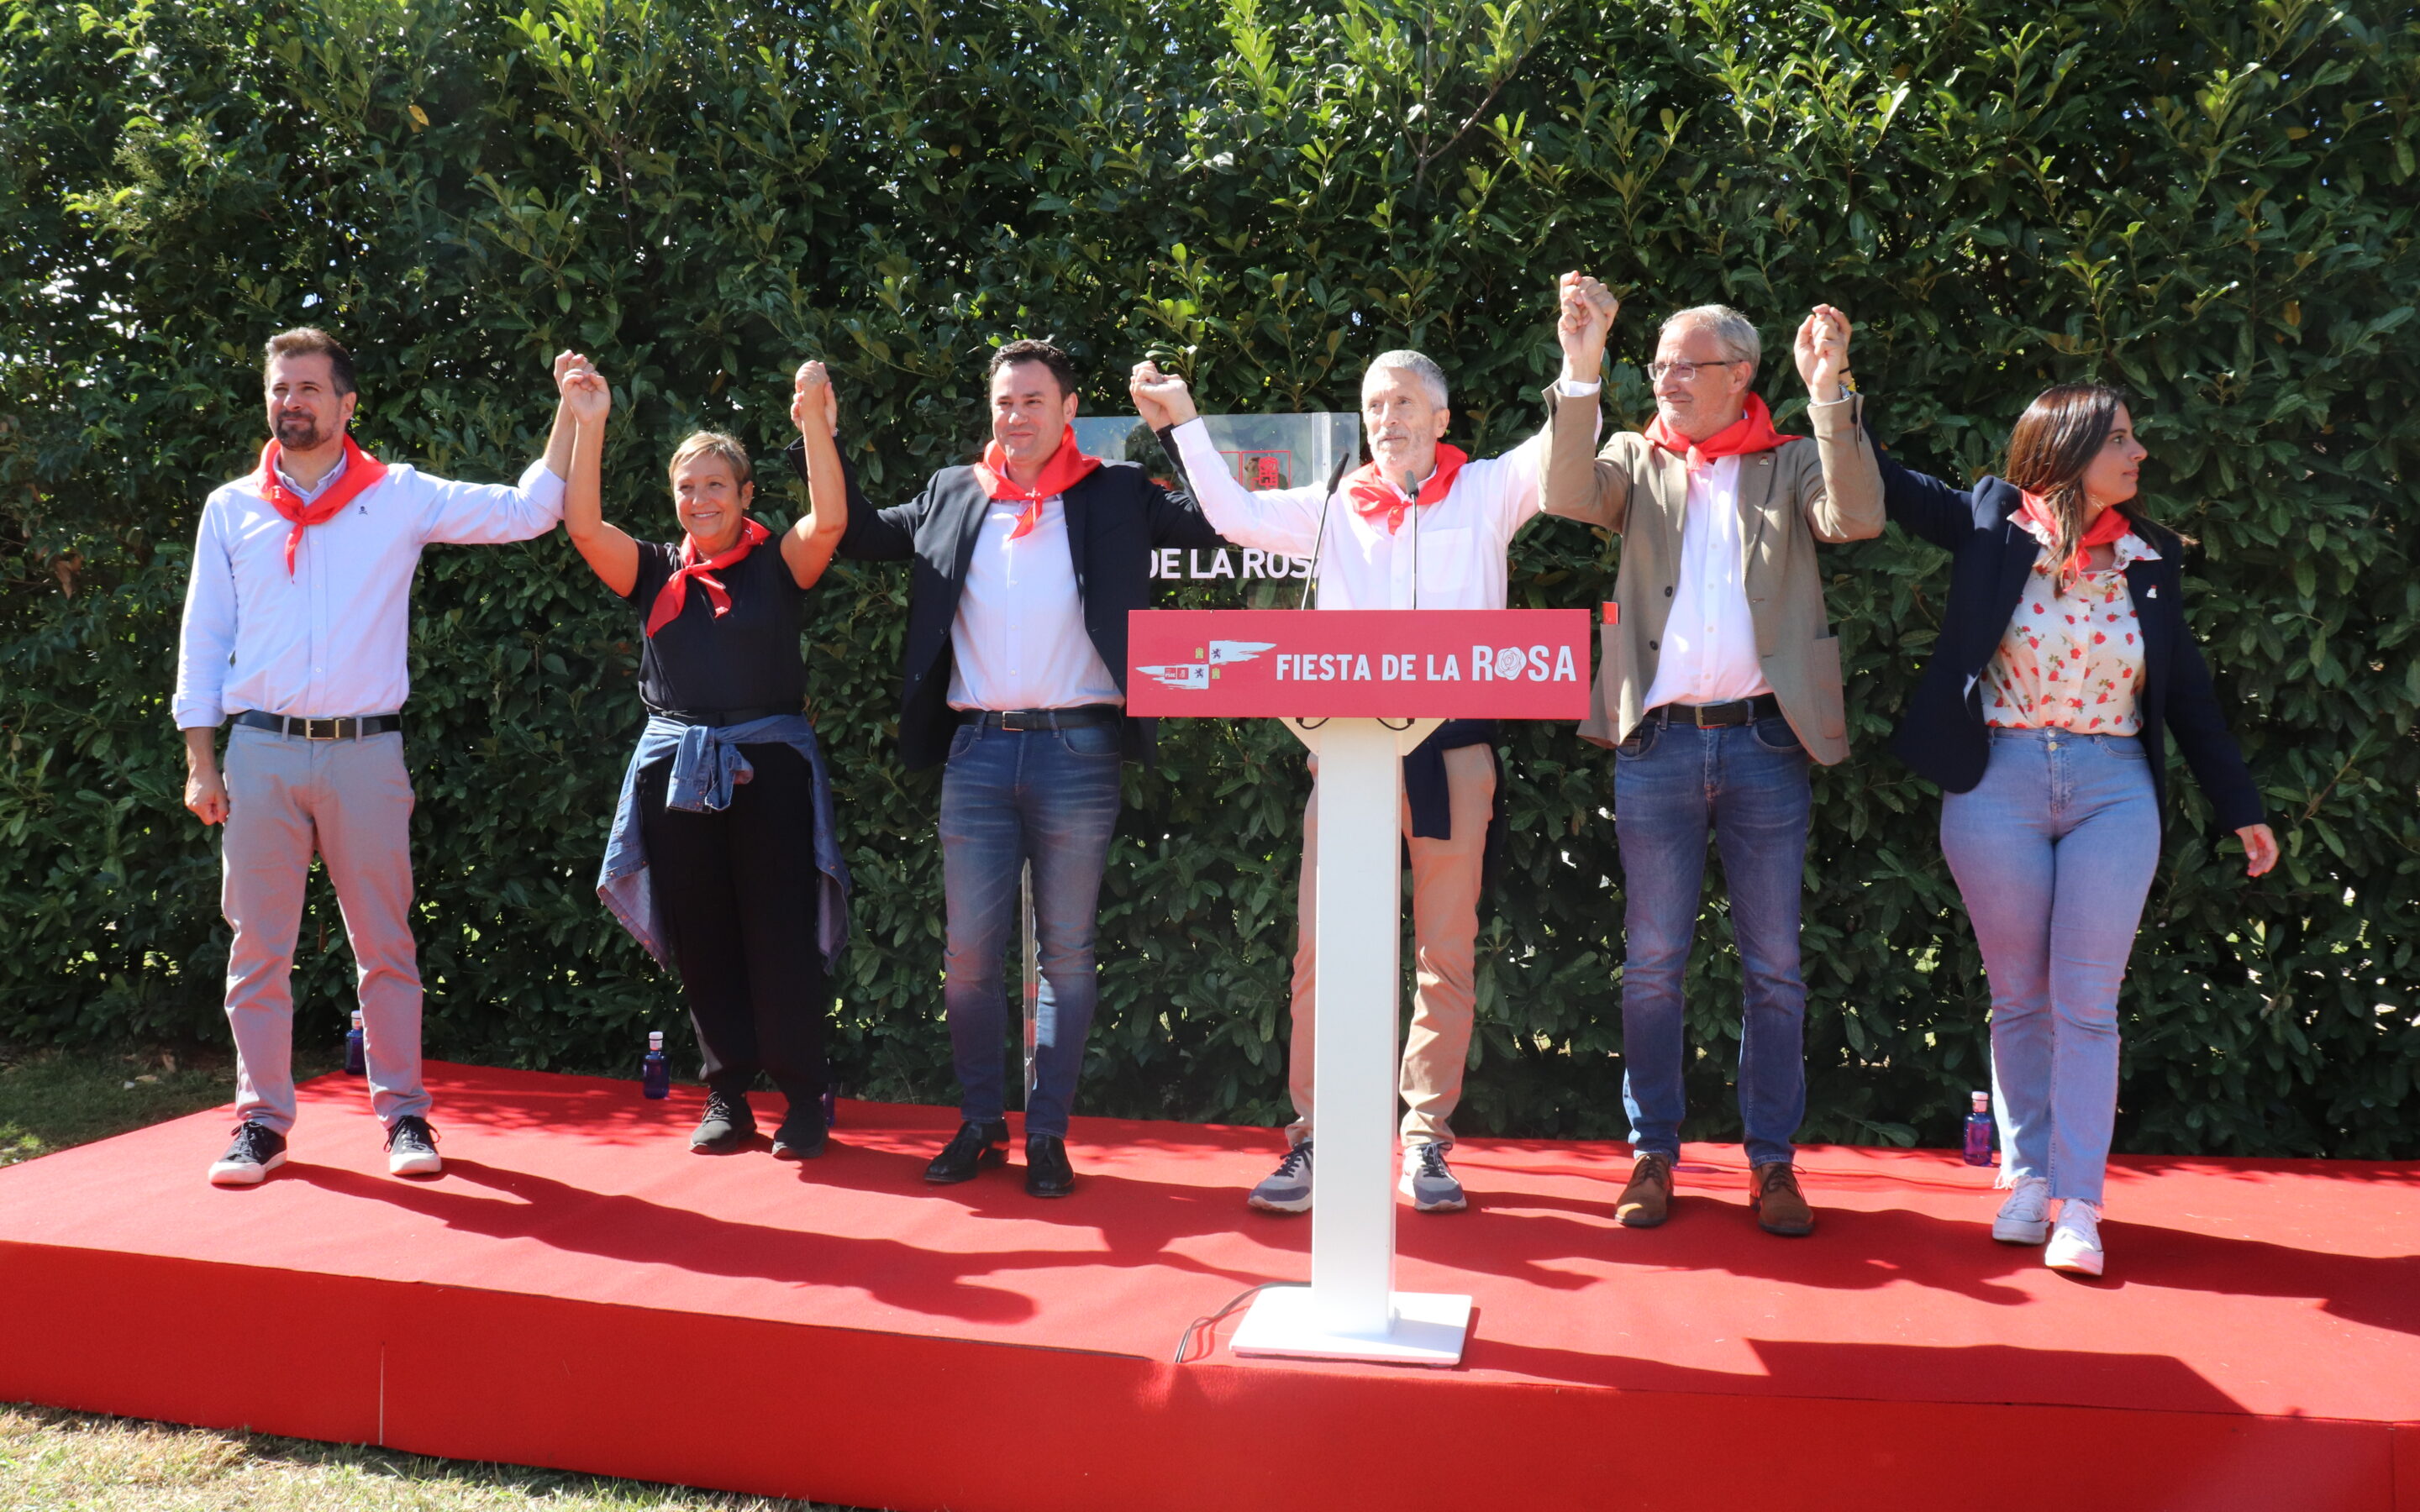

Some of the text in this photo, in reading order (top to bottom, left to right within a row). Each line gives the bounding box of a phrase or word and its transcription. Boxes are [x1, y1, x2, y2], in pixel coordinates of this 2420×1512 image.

[1191, 549, 1235, 579] LA
[1243, 549, 1320, 579] ROS
[1276, 654, 1371, 681] FIESTA
[1381, 654, 1416, 681] DE
[1426, 654, 1461, 681] LA
